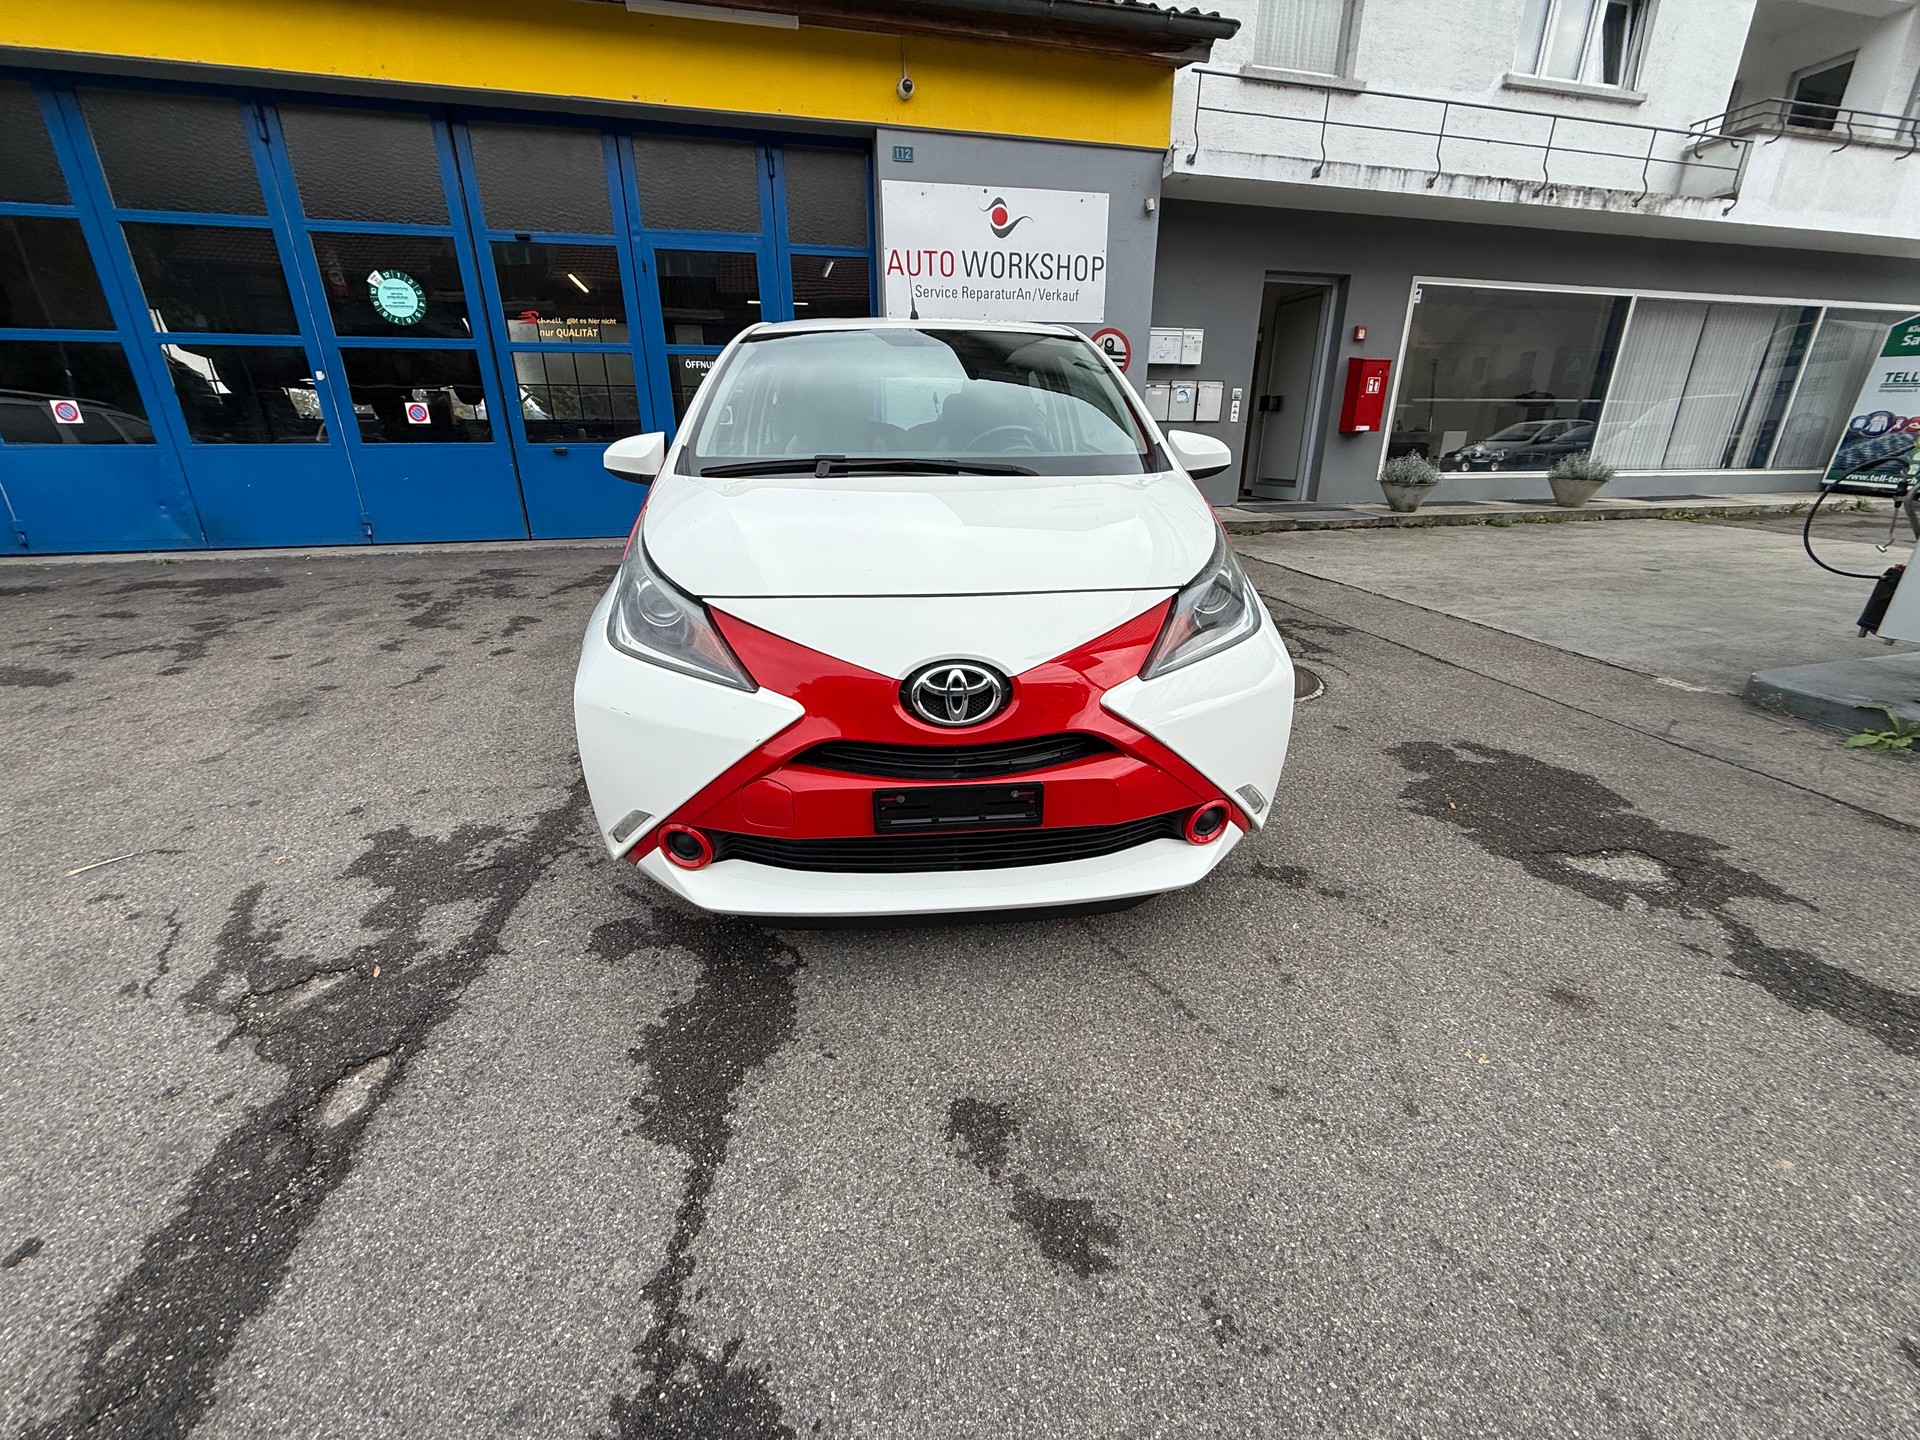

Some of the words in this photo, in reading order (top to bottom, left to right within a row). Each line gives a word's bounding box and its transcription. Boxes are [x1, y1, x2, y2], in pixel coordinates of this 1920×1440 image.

[895, 148, 911, 159] 112
[886, 249, 955, 278] AUTO
[961, 250, 1105, 282] WORKSHOP
[915, 285, 958, 299] Service
[566, 317, 578, 325] gibt
[556, 327, 598, 338] QUALITÄT
